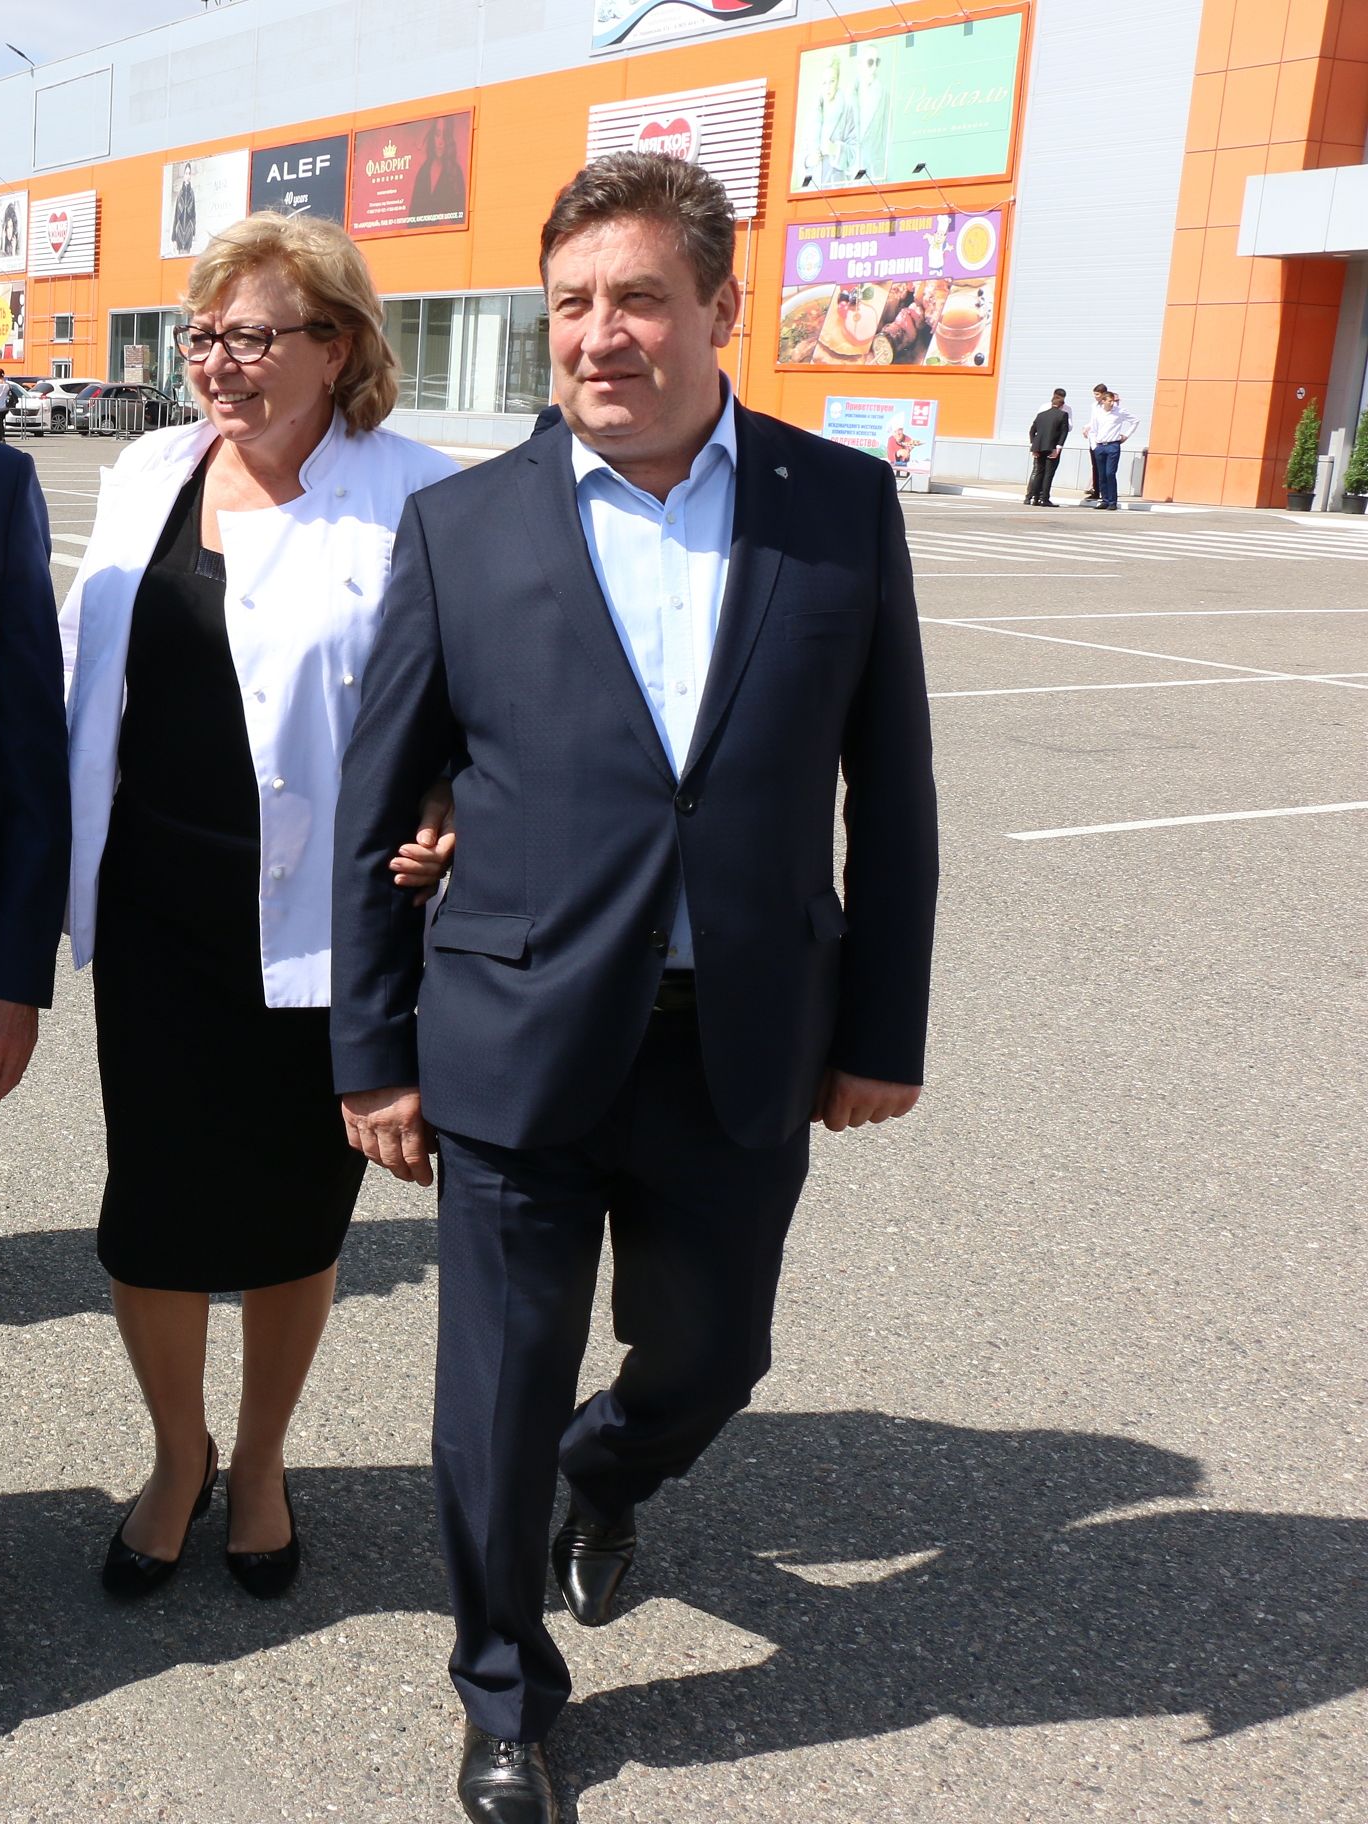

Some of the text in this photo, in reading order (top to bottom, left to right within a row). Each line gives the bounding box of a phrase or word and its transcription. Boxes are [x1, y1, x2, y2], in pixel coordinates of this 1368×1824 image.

[640, 132, 690, 154] МЯГКОЕ
[266, 154, 331, 183] ALEF
[366, 155, 412, 177] ФАВОРИТ
[284, 191, 309, 207] 40 years
[798, 216, 933, 240] Благотворительная акция
[829, 240, 878, 261] Повара
[847, 258, 872, 279] без
[874, 255, 924, 277] границ
[845, 401, 894, 413] Приветствуем
